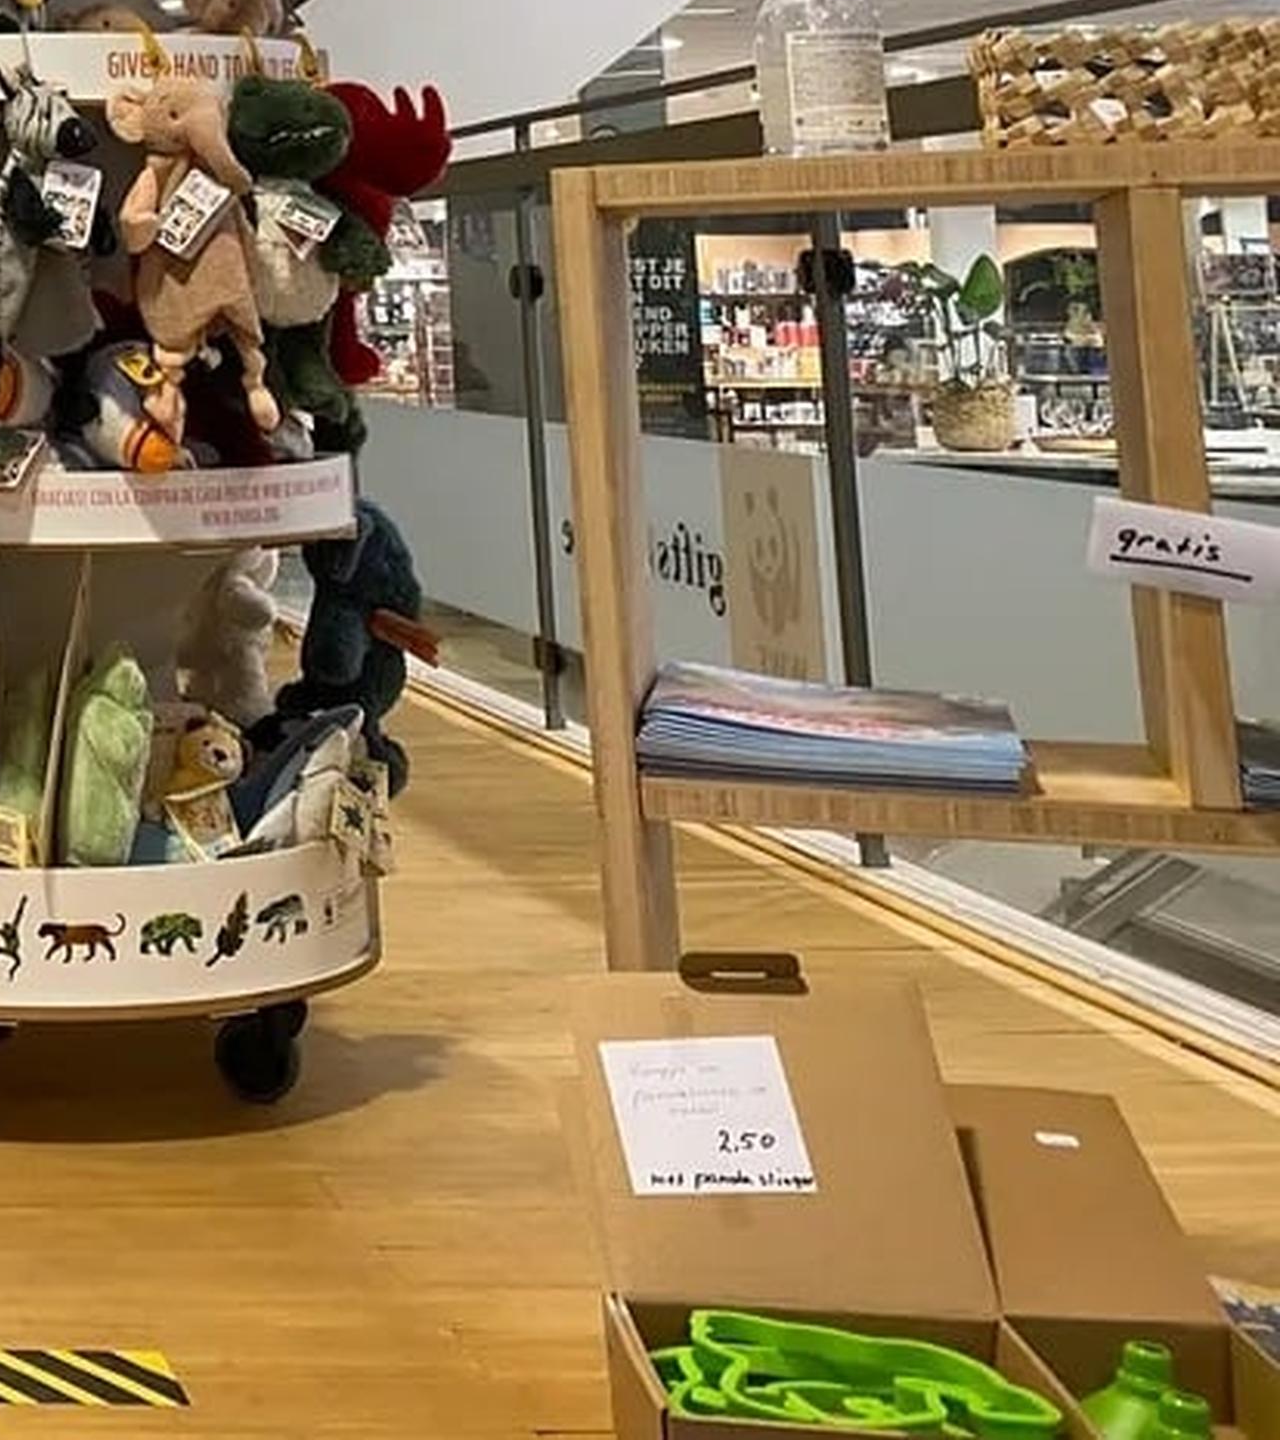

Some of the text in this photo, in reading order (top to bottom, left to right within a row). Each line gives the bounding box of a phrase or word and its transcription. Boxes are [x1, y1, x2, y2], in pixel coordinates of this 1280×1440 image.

[106, 51, 150, 79] GIVE
[173, 53, 220, 80] HAND
[1117, 527, 1222, 562] gratis
